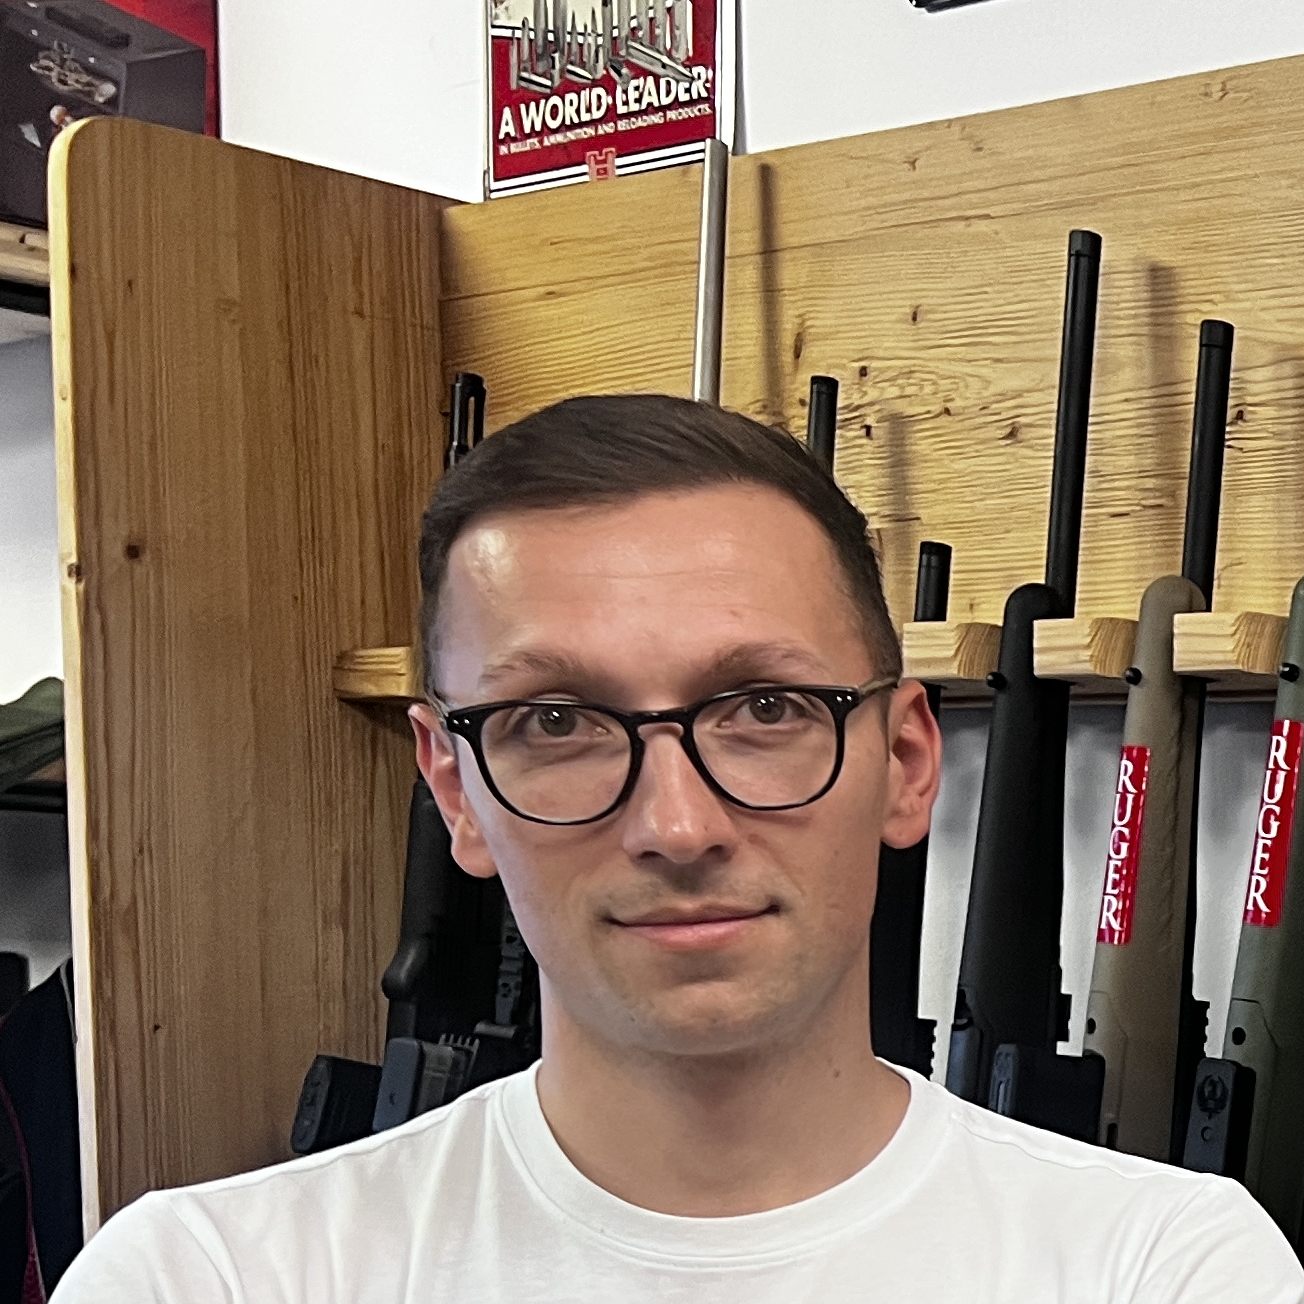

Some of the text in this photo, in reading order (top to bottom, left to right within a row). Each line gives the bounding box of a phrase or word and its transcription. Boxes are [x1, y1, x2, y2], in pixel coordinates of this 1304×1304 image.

[499, 106, 516, 140] A
[519, 86, 609, 135] WORLD
[597, 121, 616, 136] AND
[1100, 759, 1138, 931] RUGER
[1246, 735, 1290, 914] RUGER
